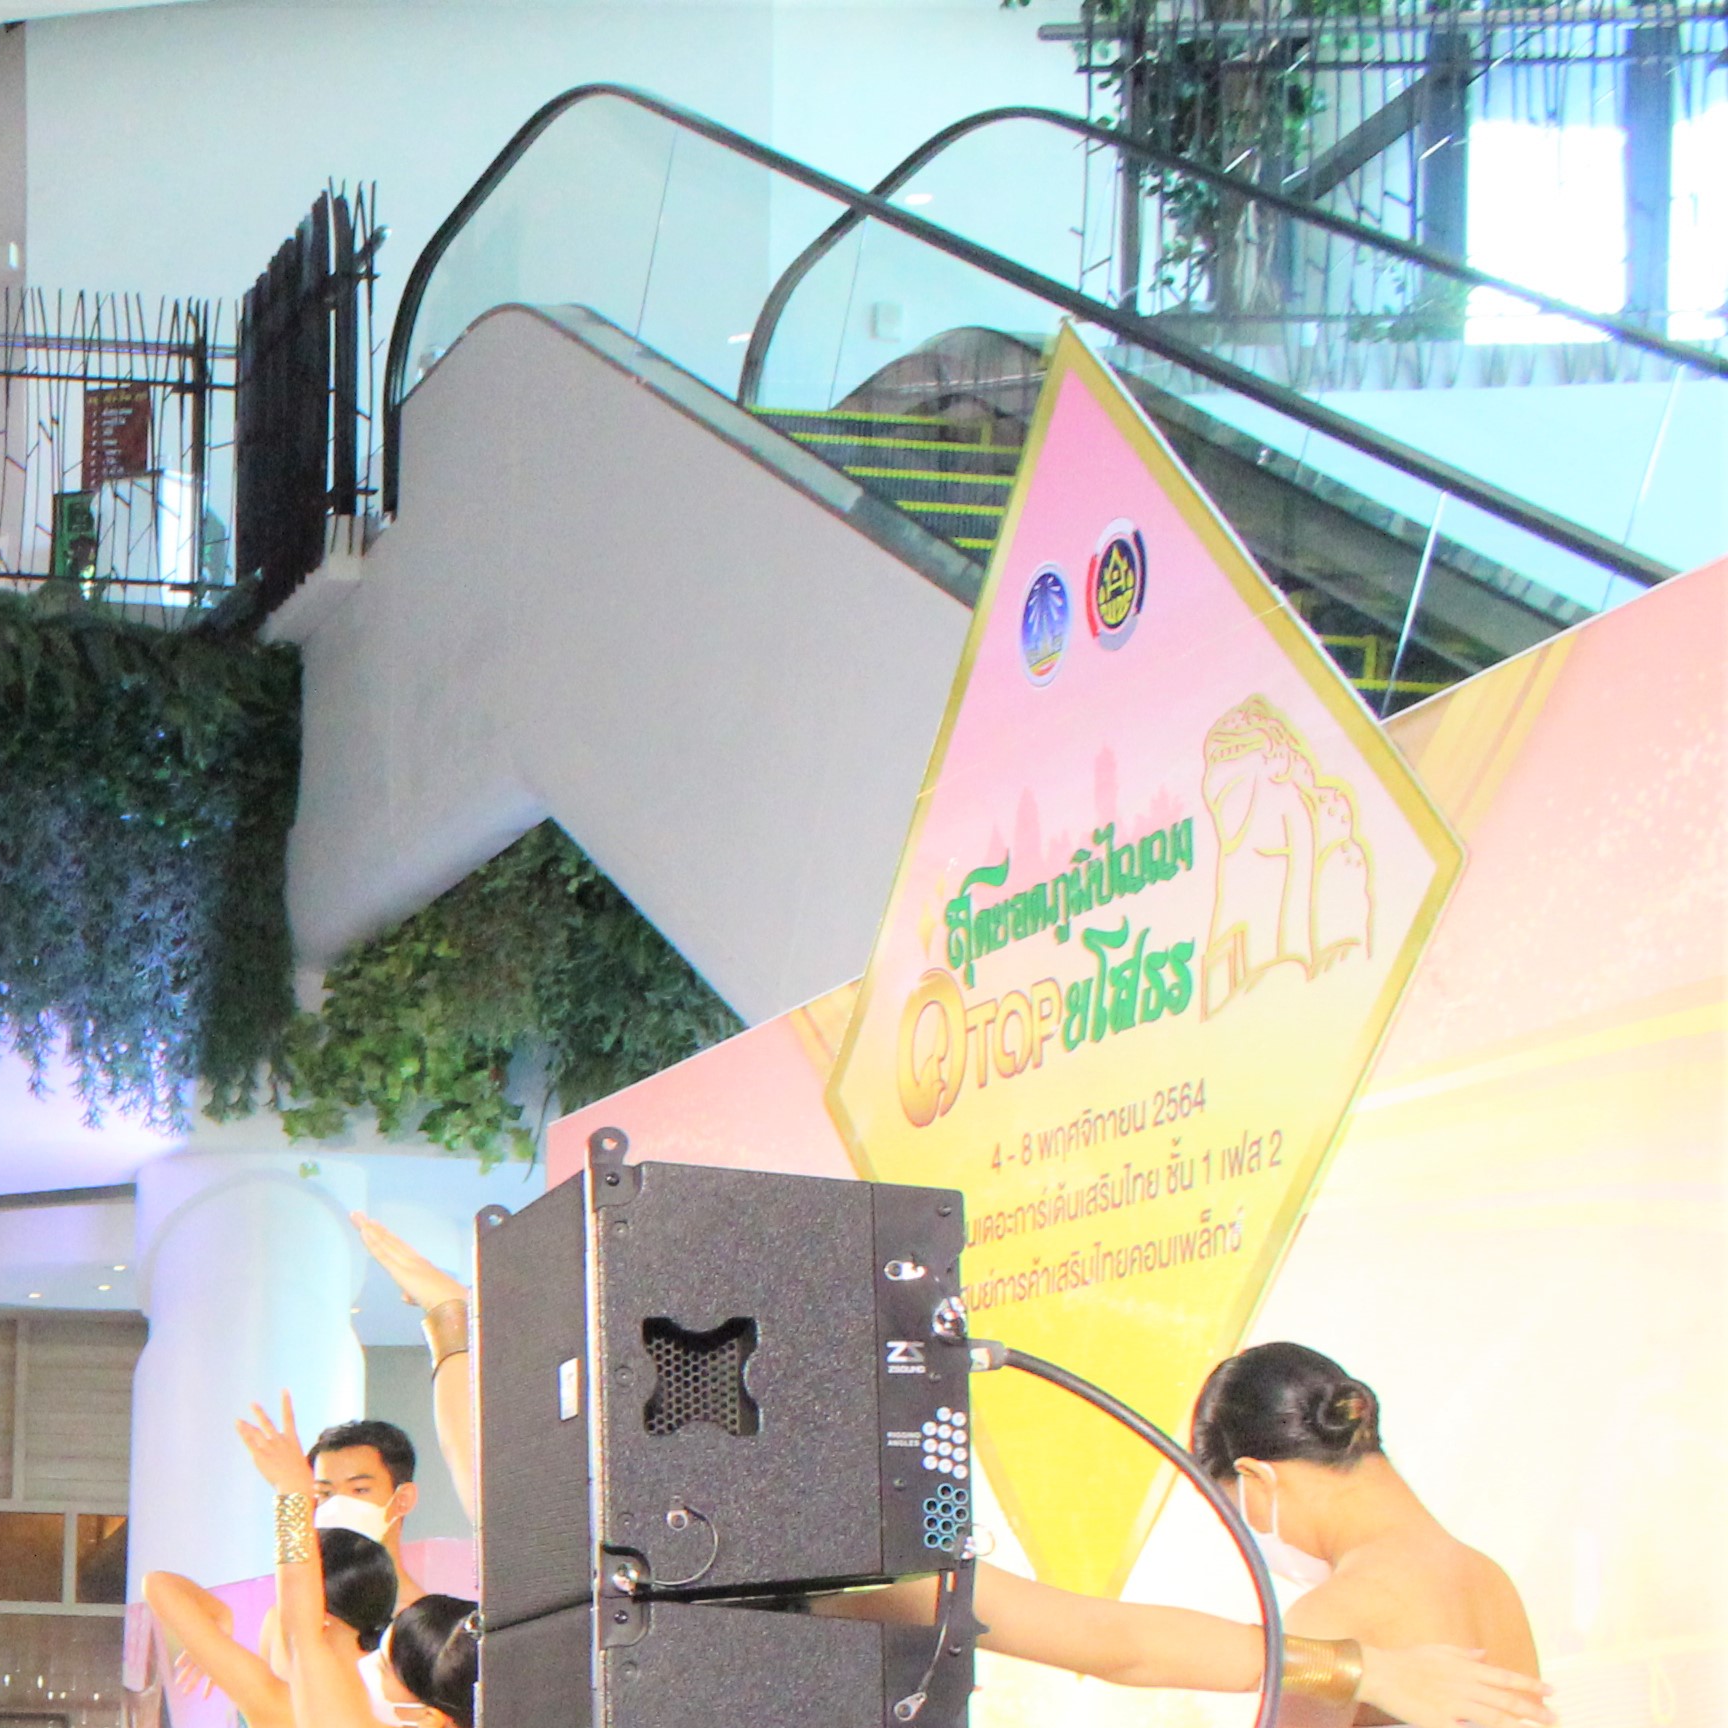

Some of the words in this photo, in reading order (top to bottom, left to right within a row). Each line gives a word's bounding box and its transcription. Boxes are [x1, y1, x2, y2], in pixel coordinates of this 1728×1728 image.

[992, 1142, 1002, 1176] 4
[1021, 1132, 1033, 1167] 8
[1037, 1099, 1147, 1163] พฤศจิกายน
[1152, 1077, 1206, 1128] 2564
[1202, 1149, 1212, 1185] 1
[1220, 1129, 1263, 1181] เฟส
[1269, 1128, 1284, 1168] 2
